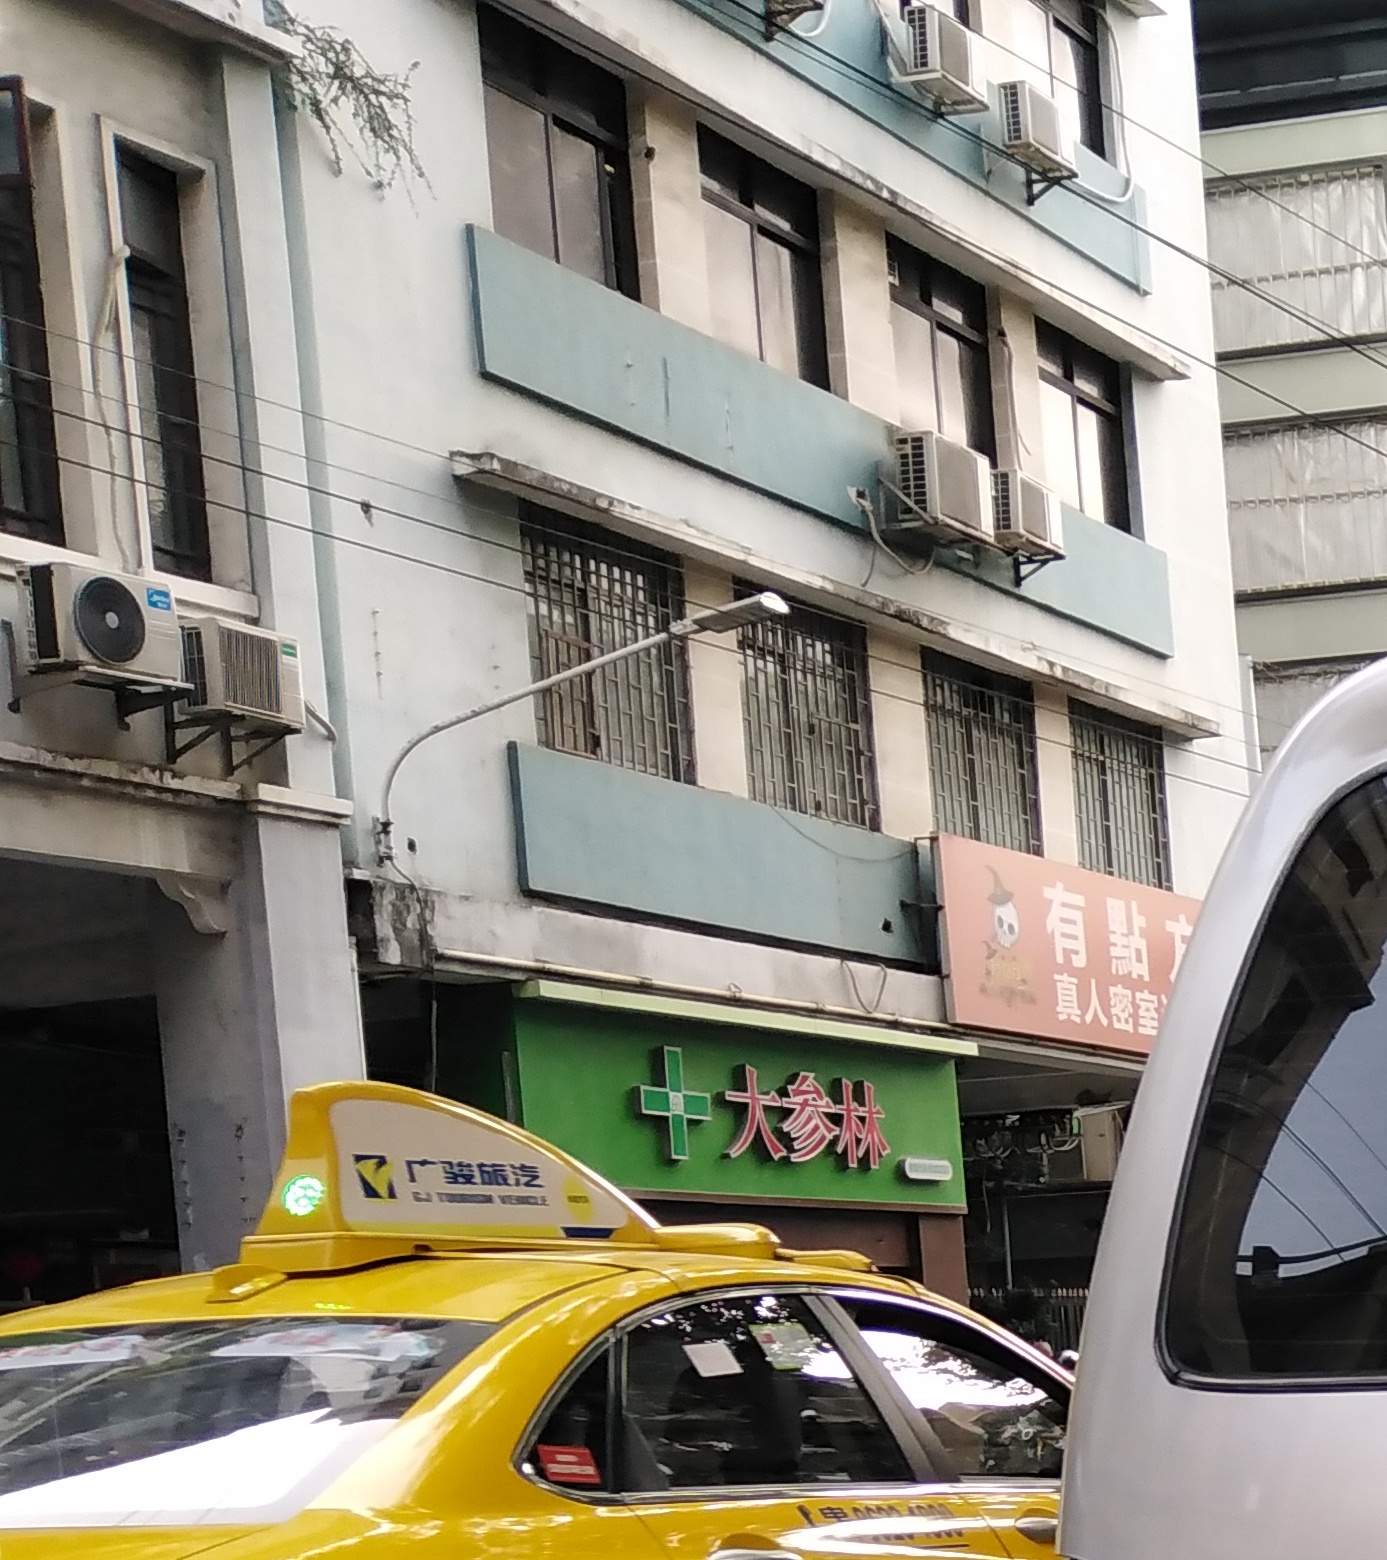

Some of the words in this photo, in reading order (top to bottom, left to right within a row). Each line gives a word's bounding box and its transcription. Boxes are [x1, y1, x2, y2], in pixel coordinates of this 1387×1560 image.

[1053, 973, 1169, 1036] 真人密室
[724, 1063, 891, 1170] 大参林
